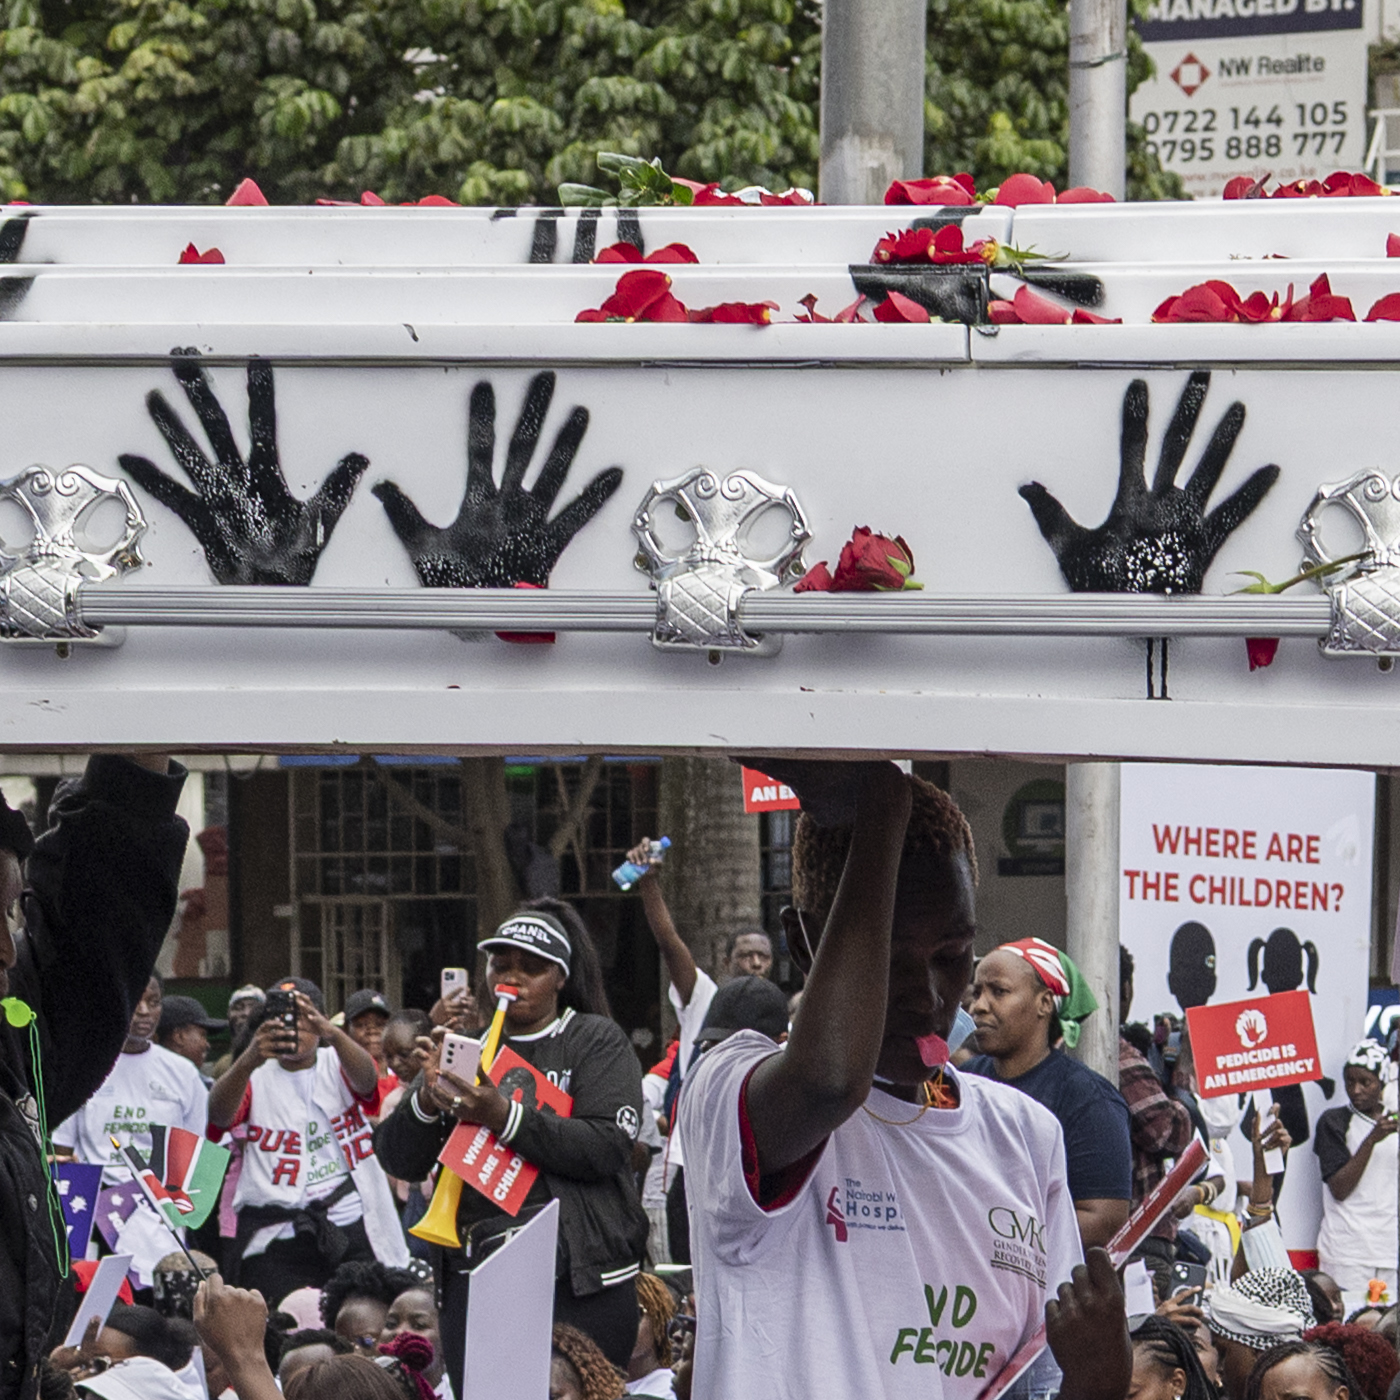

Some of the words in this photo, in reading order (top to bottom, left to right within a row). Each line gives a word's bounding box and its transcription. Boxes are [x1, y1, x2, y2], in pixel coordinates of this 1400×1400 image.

[1218, 57, 1251, 77] NW
[1257, 52, 1326, 75] Realite
[1143, 108, 1217, 134] 0722
[1229, 105, 1283, 130] 144
[1296, 100, 1348, 126] 105
[1225, 134, 1283, 160] 888
[1293, 131, 1348, 156] 777
[751, 786, 778, 803] AN
[1152, 823, 1257, 861] WHERE
[1266, 832, 1321, 864] ARE
[1124, 869, 1180, 903] THE
[1189, 873, 1344, 912] CHILDREN?
[1216, 1046, 1279, 1070] PEDICIDE
[1280, 1043, 1298, 1059] IS
[1204, 1073, 1228, 1090] AN
[1228, 1057, 1315, 1086] EMERGENCY
[113, 1105, 146, 1120] END
[477, 1153, 500, 1186] ARE
[493, 1152, 525, 1202] CHILD
[844, 1177, 861, 1188] The
[846, 1189, 883, 1203] Nairobi
[846, 1200, 903, 1222] Hosp
